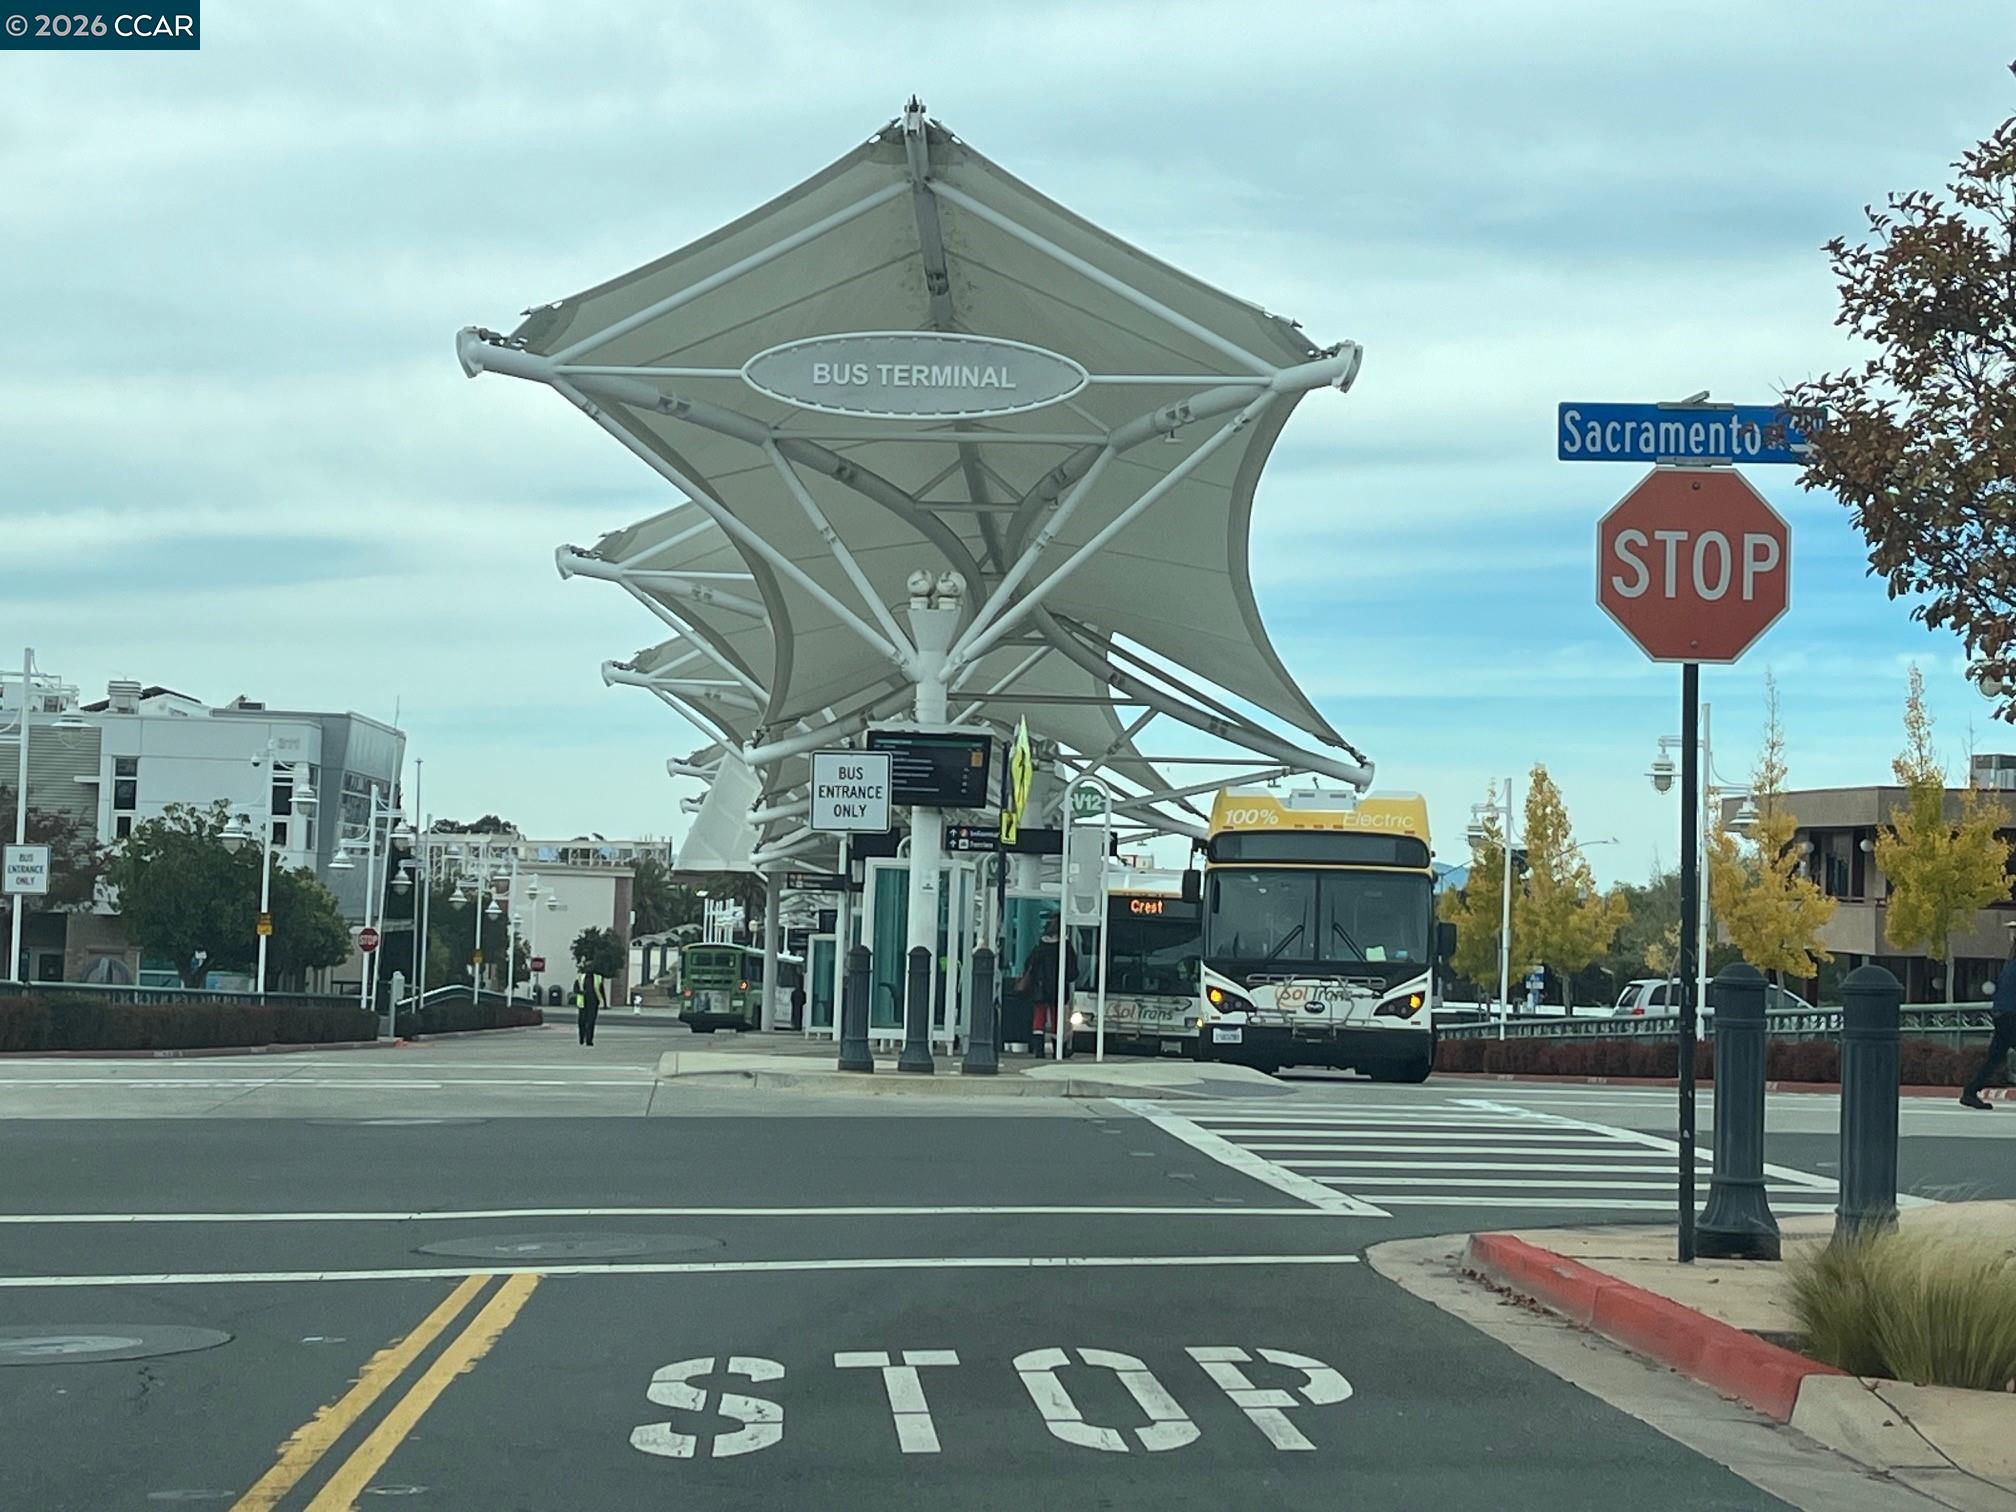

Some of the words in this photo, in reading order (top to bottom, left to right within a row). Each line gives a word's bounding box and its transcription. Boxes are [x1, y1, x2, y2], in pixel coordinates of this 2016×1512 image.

[813, 362, 868, 386] BUS
[876, 364, 1017, 389] TERMINAL
[1564, 409, 1761, 455] Sacramento
[1612, 528, 1780, 601] STOP
[838, 766, 864, 780] BUS
[818, 785, 883, 799] ENTRANCE
[833, 804, 867, 818] ONLY
[1073, 793, 1102, 811] V12
[1225, 809, 1280, 825] 100%
[1343, 812, 1415, 829] Electric
[1130, 899, 1163, 915] Crest
[359, 934, 378, 946] STOP
[629, 1346, 1354, 1458] STOP
